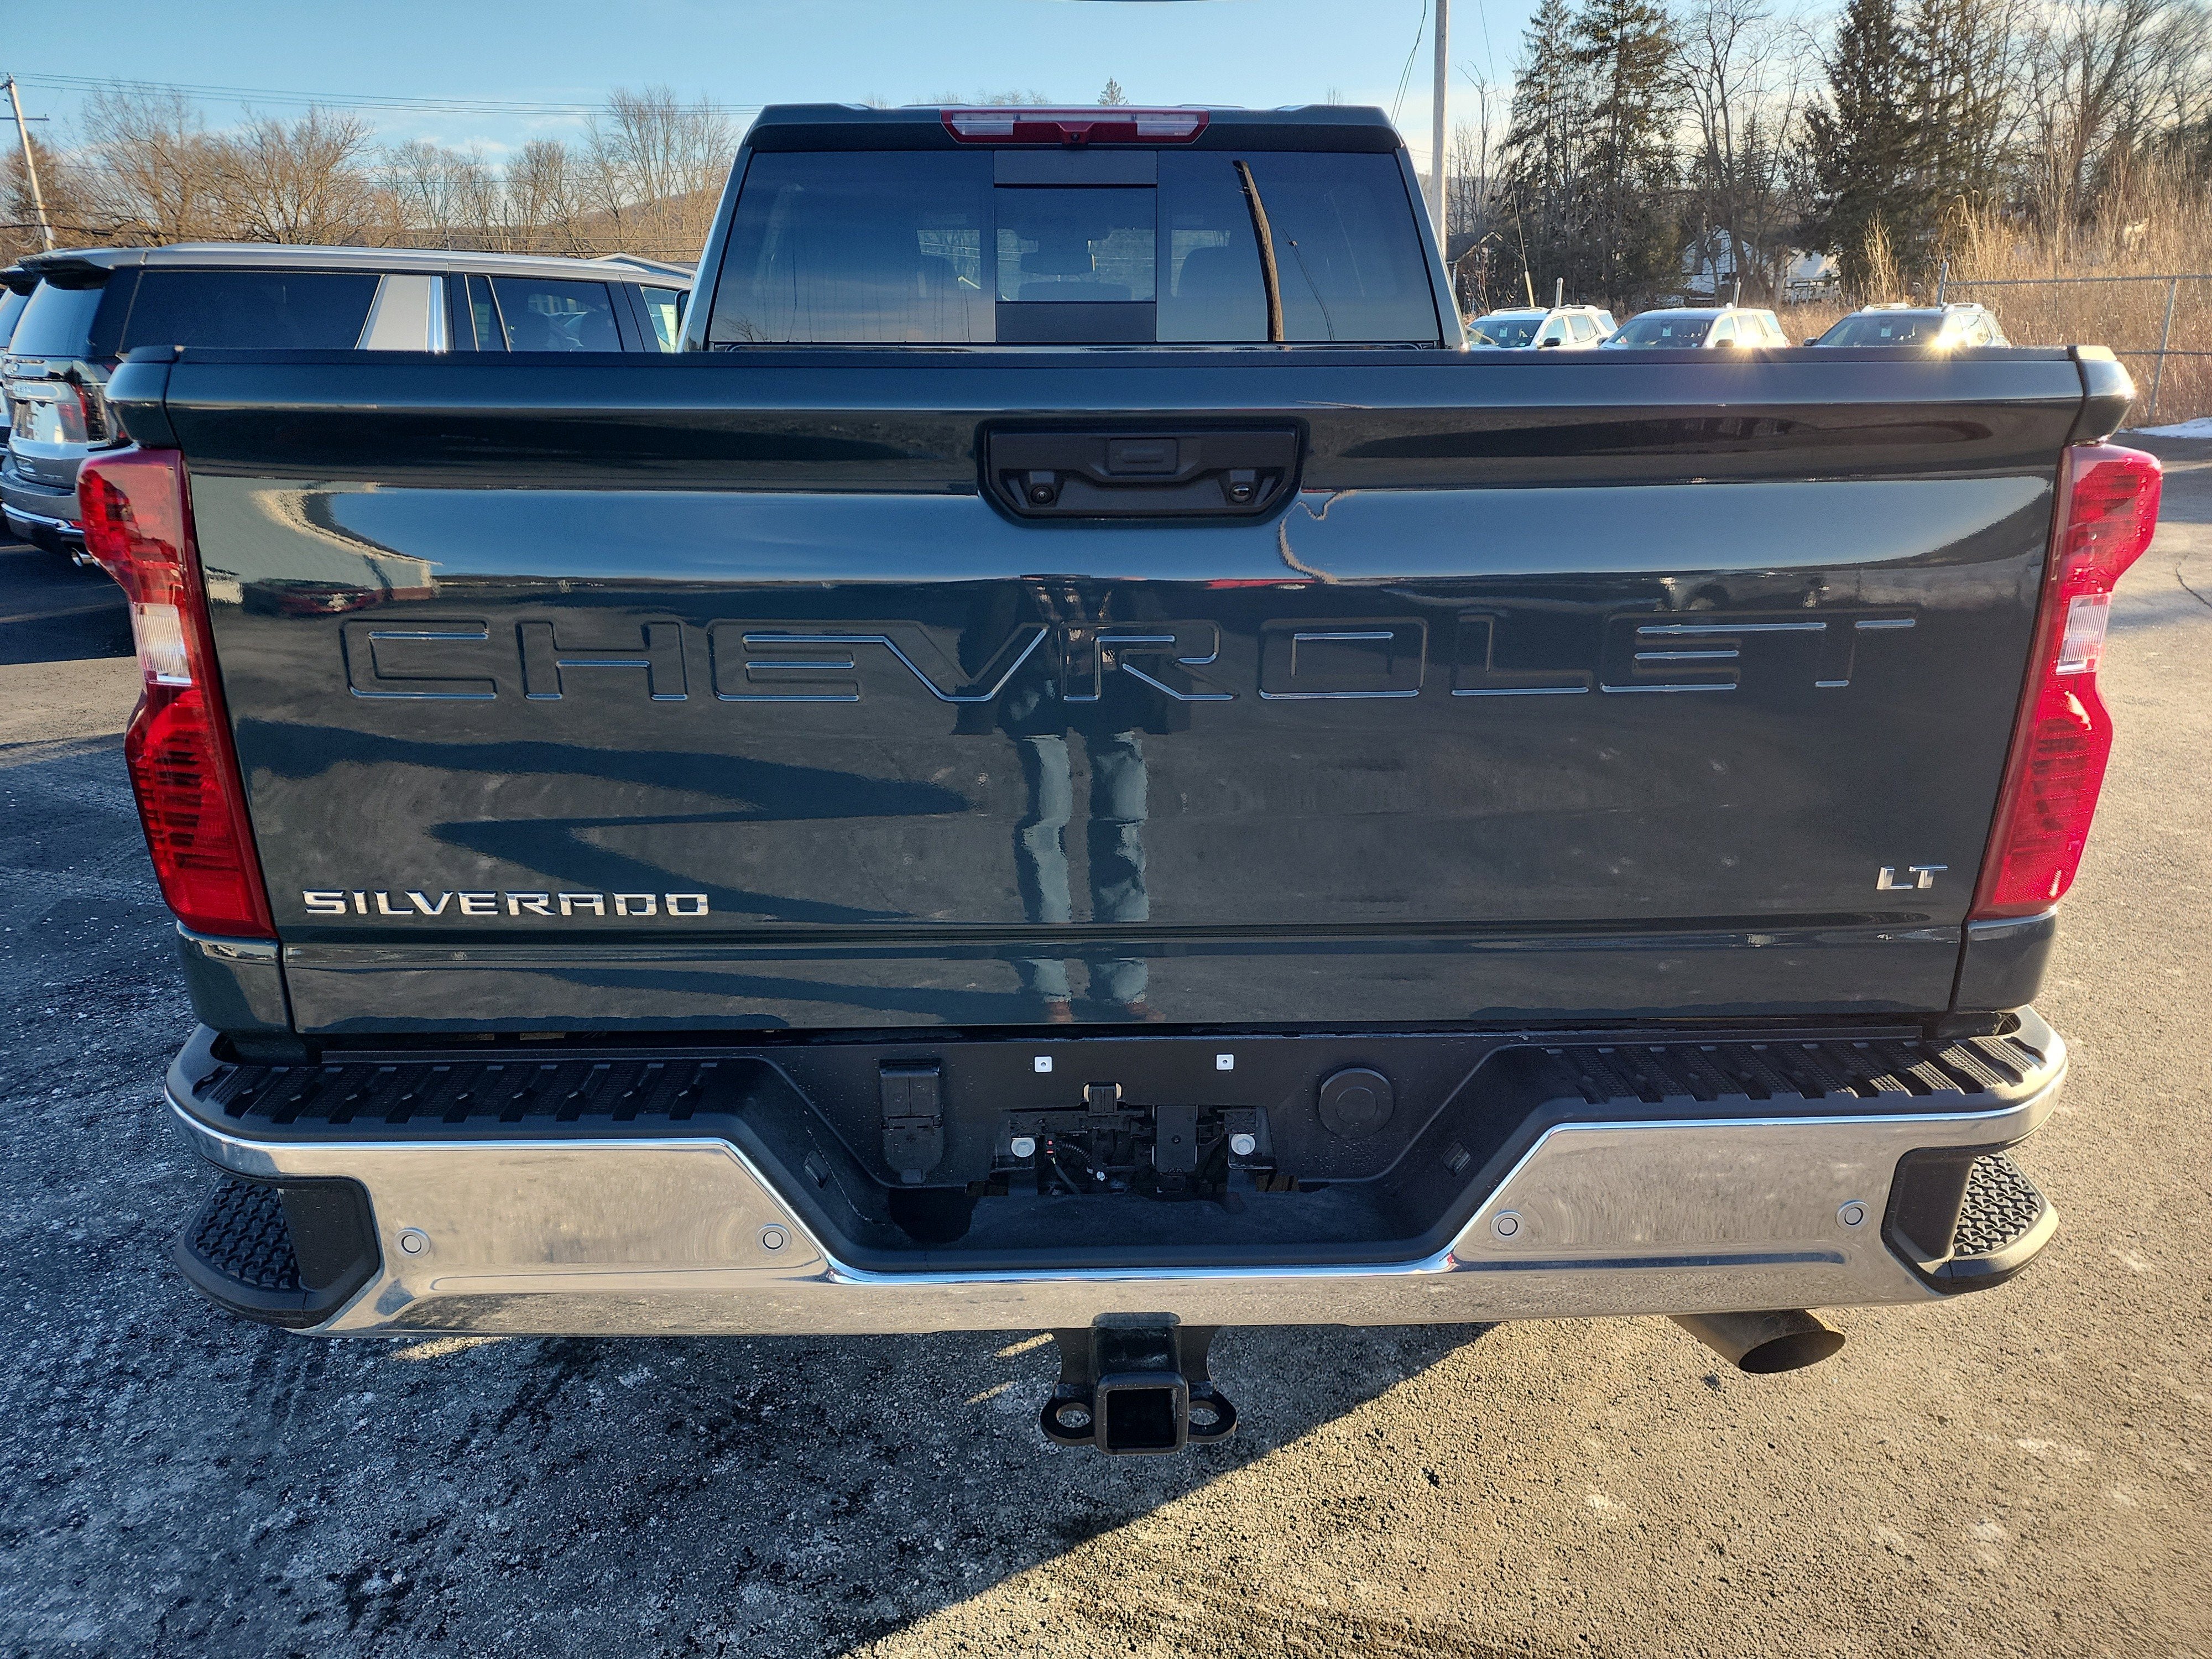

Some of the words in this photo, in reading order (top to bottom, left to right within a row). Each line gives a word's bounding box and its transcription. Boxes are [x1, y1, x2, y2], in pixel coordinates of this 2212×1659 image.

[340, 611, 1918, 702] CHEVROLET
[1876, 864, 1948, 890] LT
[302, 889, 710, 916] SILVERADO
